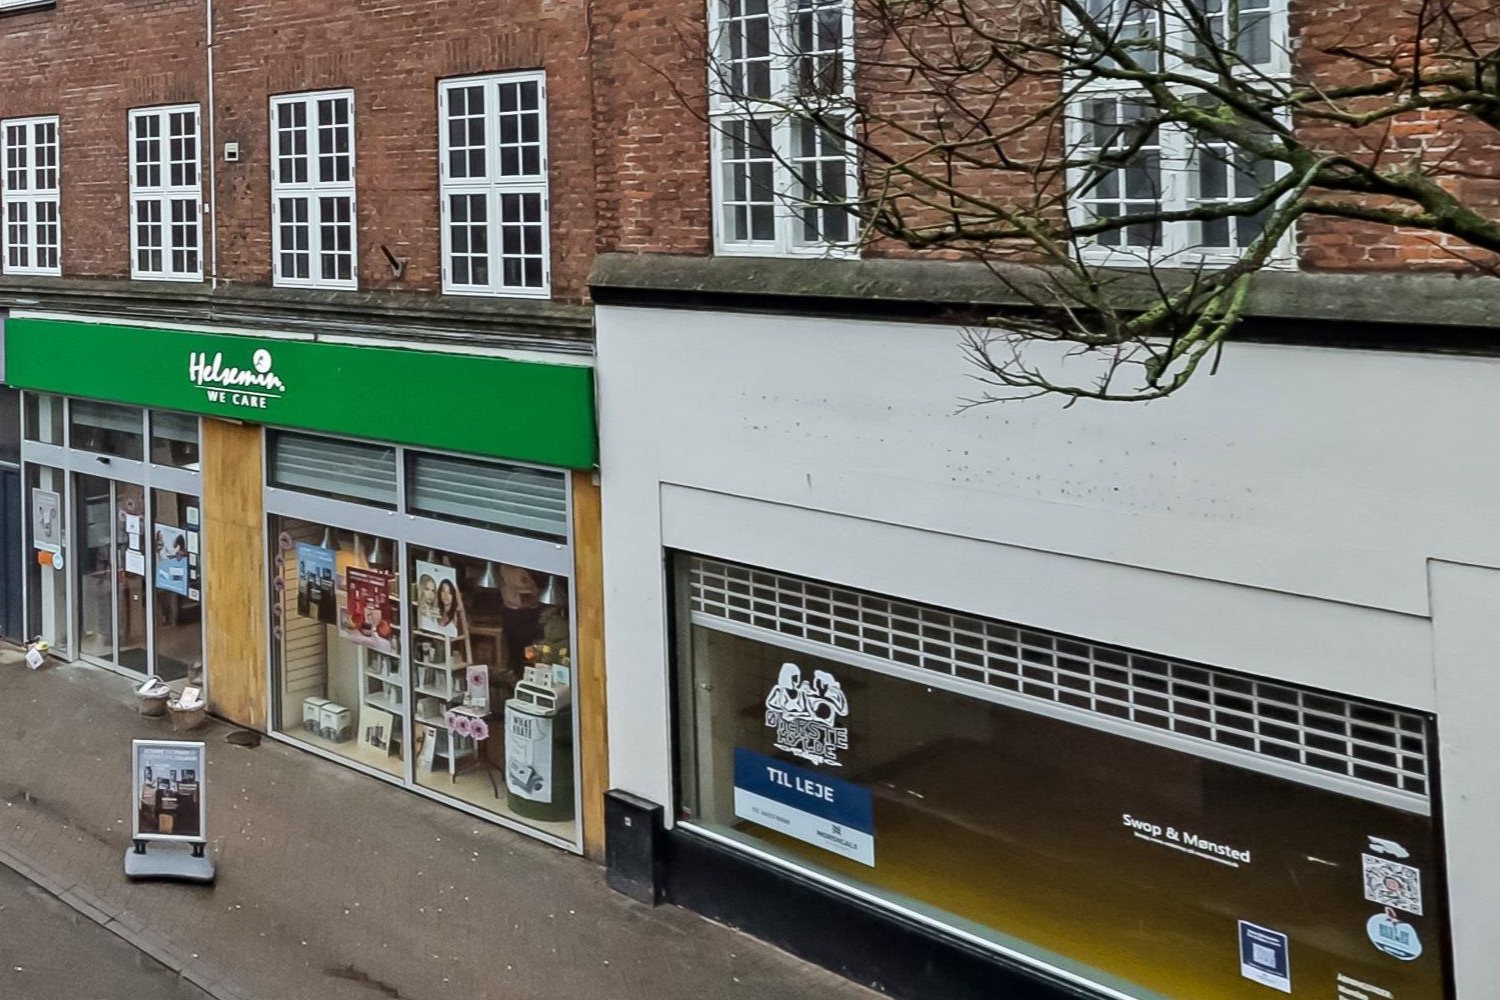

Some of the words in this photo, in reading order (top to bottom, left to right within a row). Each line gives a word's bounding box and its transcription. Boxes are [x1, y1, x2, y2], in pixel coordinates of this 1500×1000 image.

[189, 349, 283, 390] Helsemin
[207, 390, 226, 403] WE
[232, 394, 266, 408] CARE
[766, 766, 792, 788] TIL
[796, 777, 835, 803] LEJE
[1122, 813, 1162, 837] Swop
[1166, 827, 1180, 841] &
[1183, 832, 1251, 863] Mønsted
